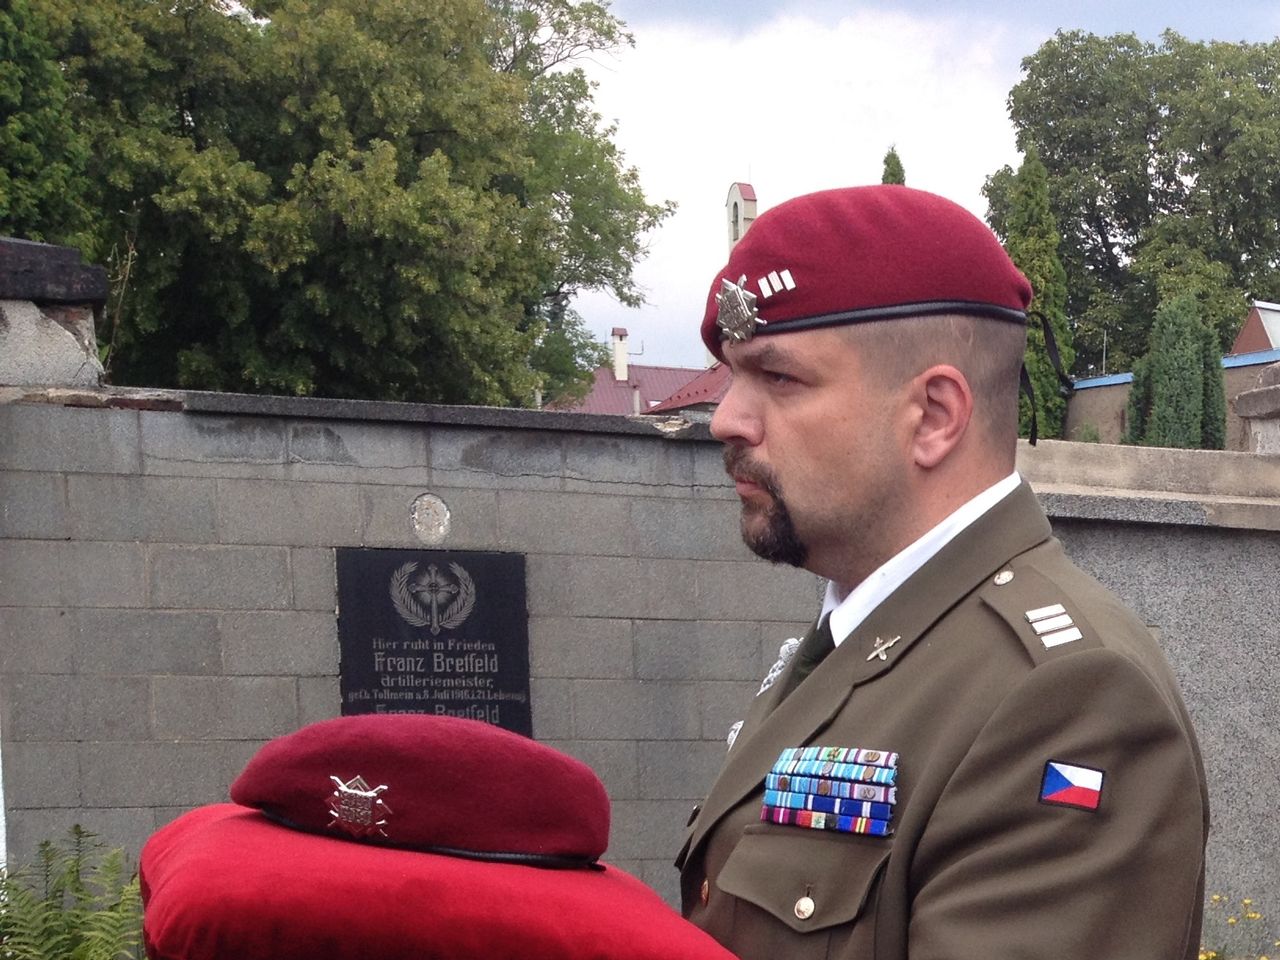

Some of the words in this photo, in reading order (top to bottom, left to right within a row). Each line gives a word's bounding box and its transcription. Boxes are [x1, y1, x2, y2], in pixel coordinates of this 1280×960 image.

[372, 638, 399, 651] Hier
[403, 639, 430, 651] ruht
[434, 639, 444, 651] in
[447, 639, 496, 651] Frieden
[374, 651, 426, 672] Franz
